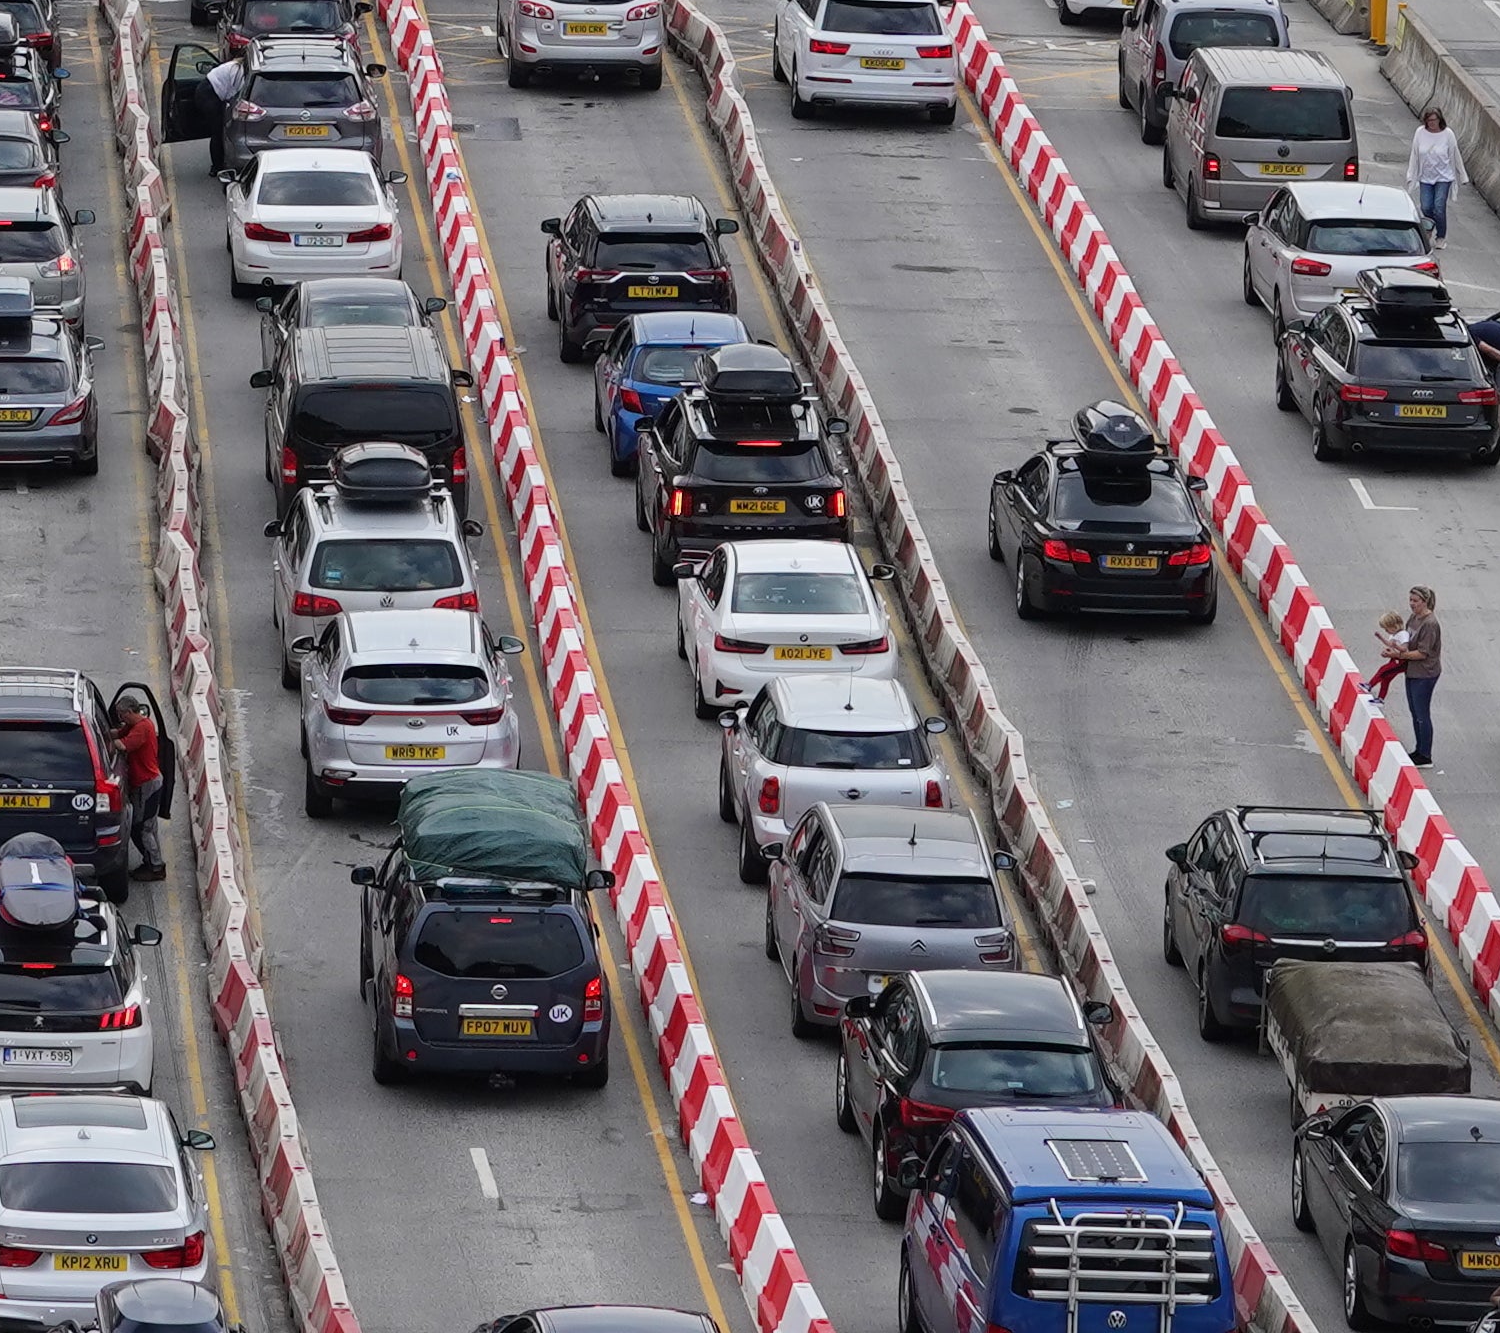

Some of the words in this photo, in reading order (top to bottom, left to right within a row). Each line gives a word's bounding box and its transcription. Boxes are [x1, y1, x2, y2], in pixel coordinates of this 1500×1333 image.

[1402, 406, 1423, 417] OV14
[1424, 406, 1444, 418] VZN
[806, 497, 822, 507] UK
[1110, 556, 1134, 567] RX13
[1135, 558, 1154, 569] OET
[780, 647, 805, 659] AO21
[805, 649, 827, 660] JYE
[446, 726, 460, 737] UK
[391, 746, 416, 757] WR19
[417, 747, 439, 758] TKF
[2, 795, 19, 807] M4
[21, 796, 42, 808] ALY
[75, 797, 92, 808] UK
[551, 1007, 568, 1020] UK
[466, 1021, 501, 1035] FP07
[502, 1021, 529, 1035] WUV
[61, 1256, 92, 1270] KP12
[93, 1256, 121, 1270] XRU
